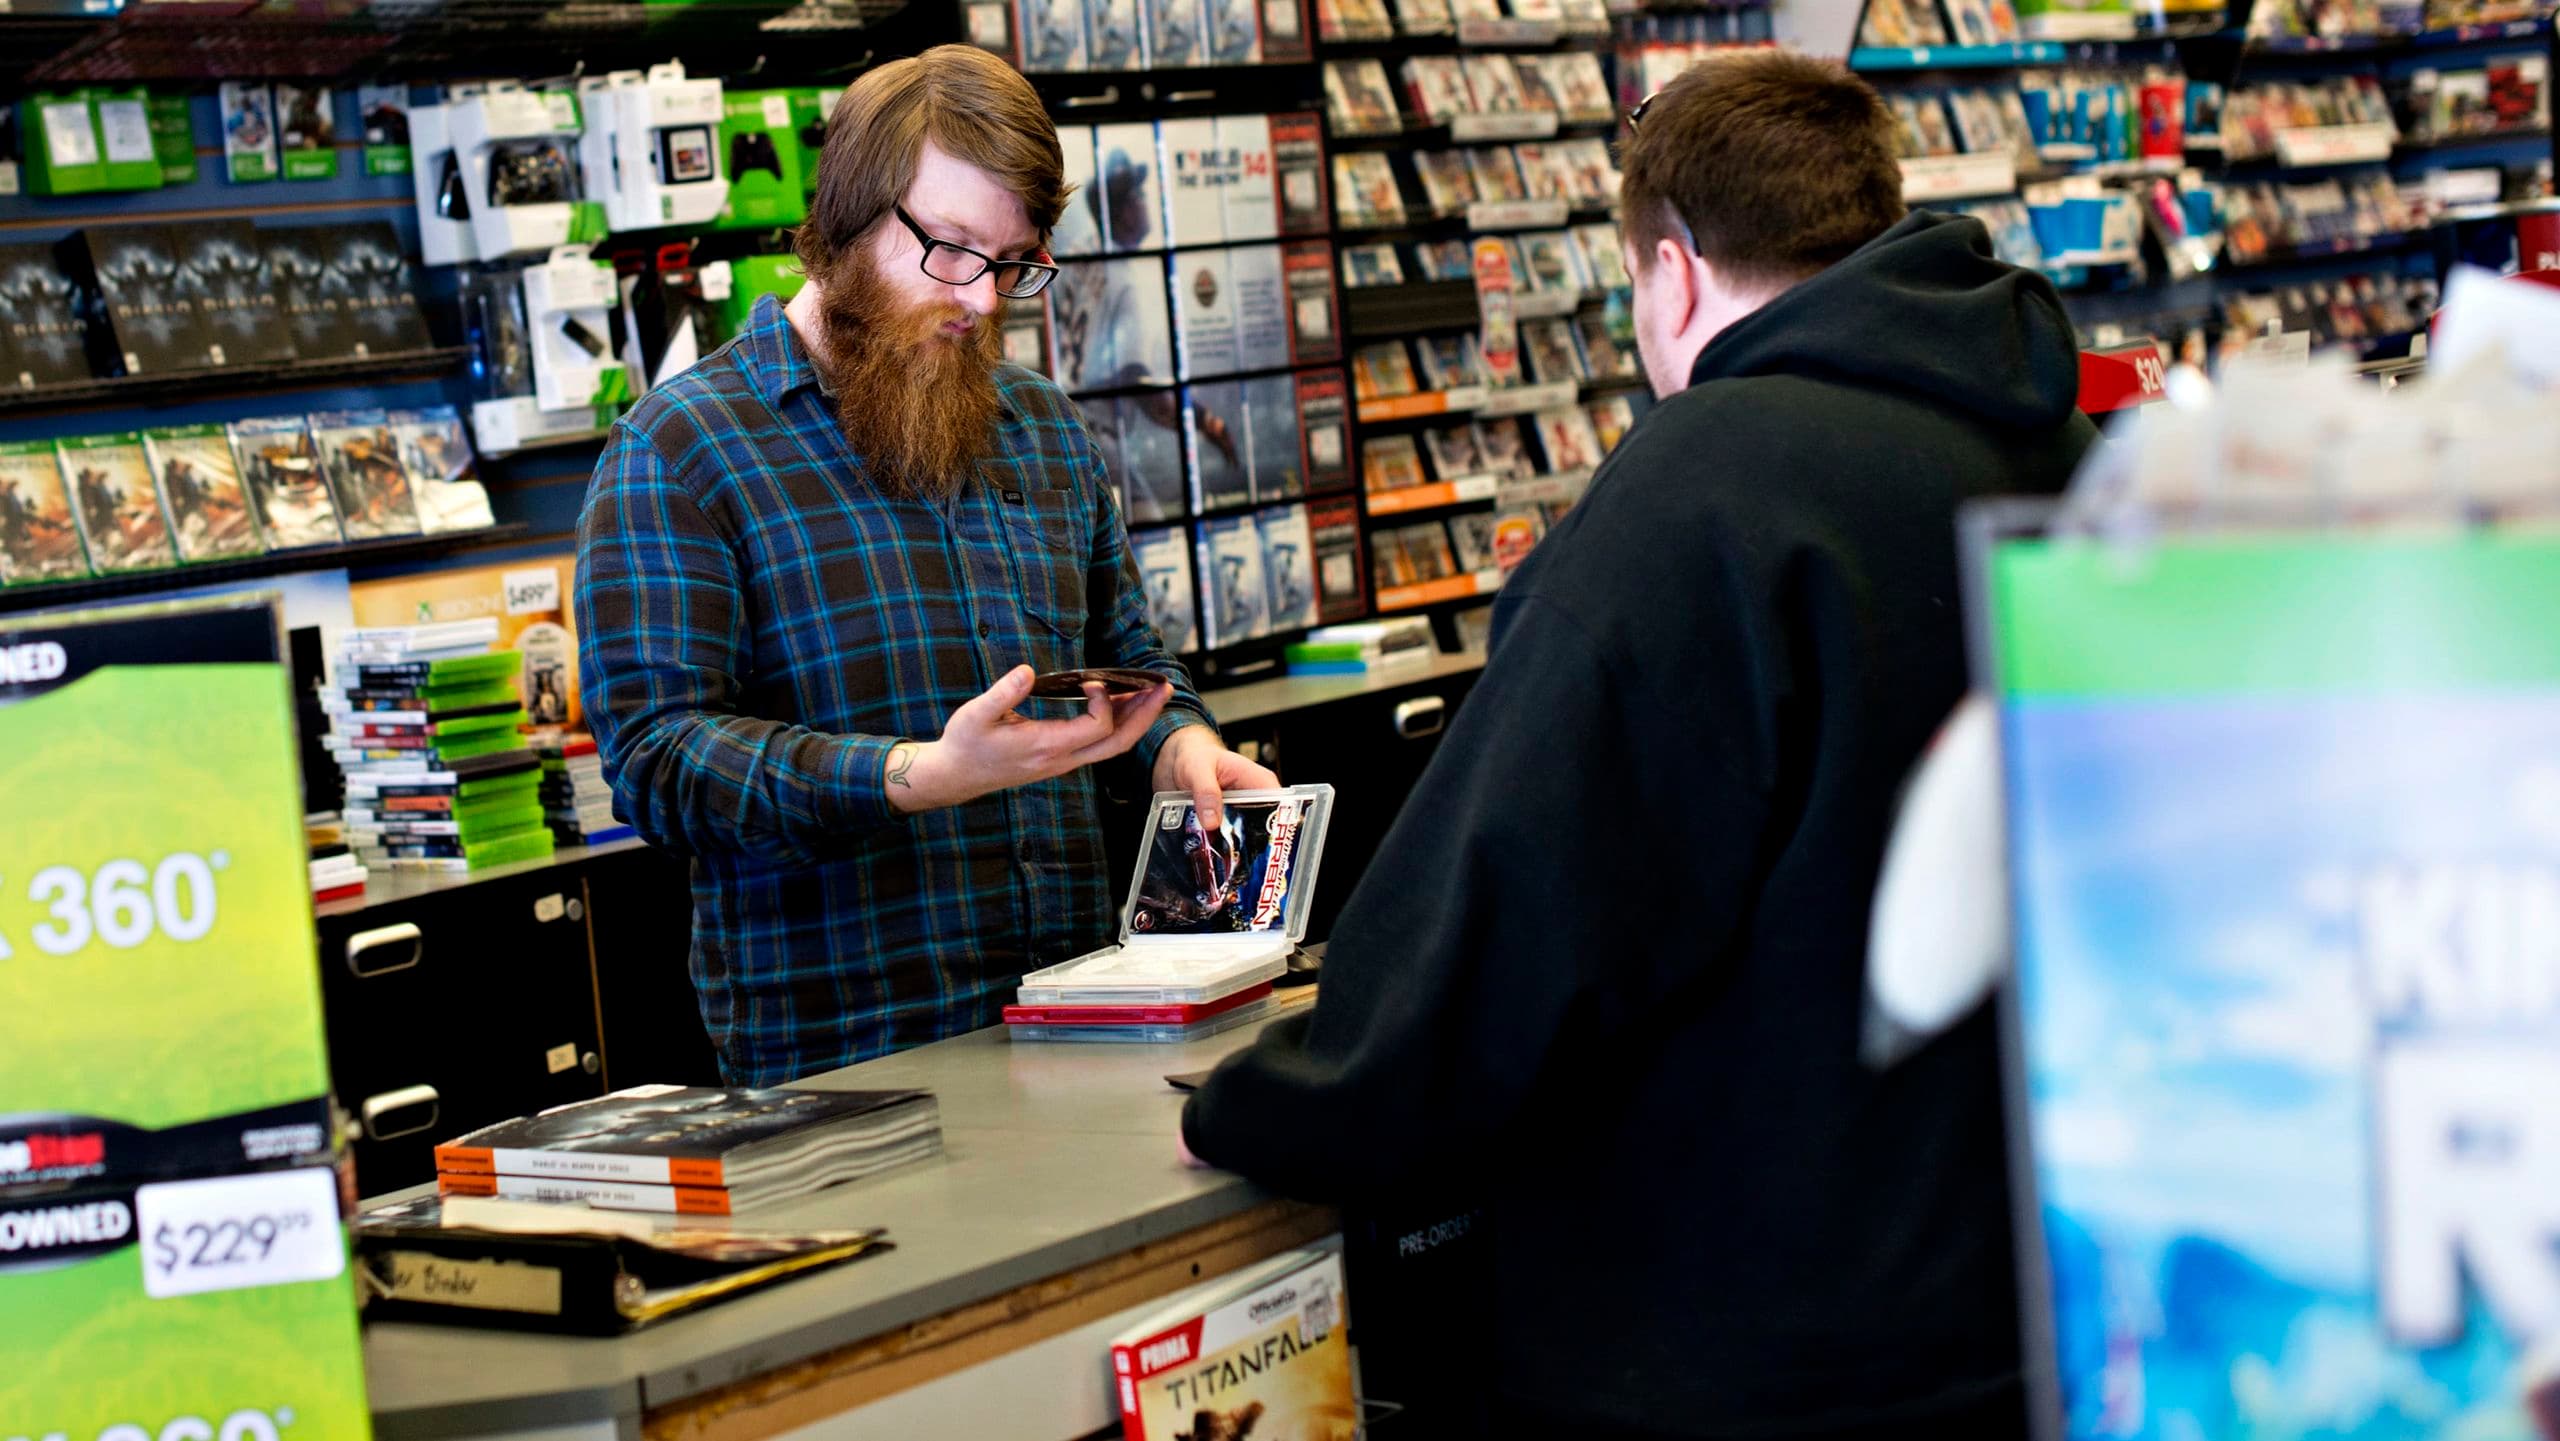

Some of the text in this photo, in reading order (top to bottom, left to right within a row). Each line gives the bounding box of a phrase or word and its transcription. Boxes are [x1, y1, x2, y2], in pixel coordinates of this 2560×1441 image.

[29, 852, 217, 957] 360
[0, 1200, 131, 1251] OWNED
[1399, 1213, 1471, 1257] PRE-ORDER
[1138, 1333, 1190, 1374] PRIMA
